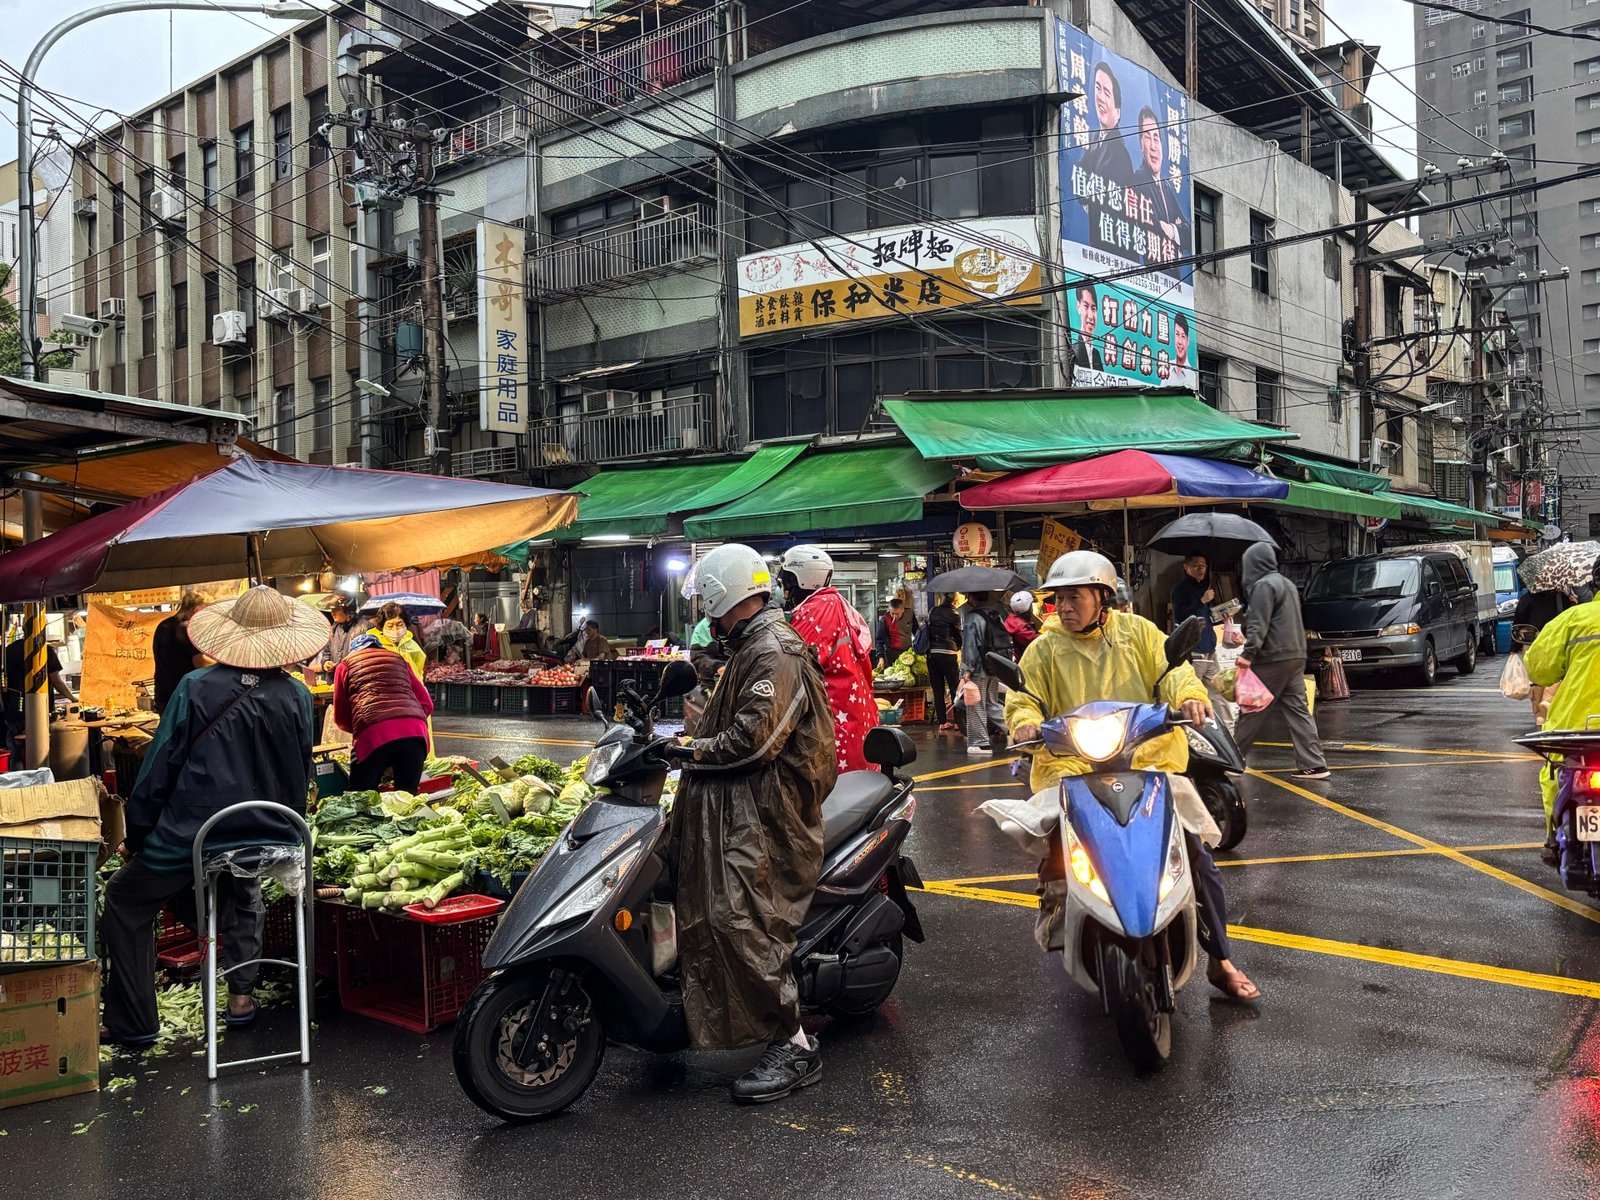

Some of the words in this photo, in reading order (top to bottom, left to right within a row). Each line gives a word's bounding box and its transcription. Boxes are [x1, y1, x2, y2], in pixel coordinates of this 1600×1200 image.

[1071, 164, 1154, 226] 值得您信任
[871, 229, 954, 268] 招牌麵
[1098, 211, 1177, 265] 值得您期待
[767, 295, 778, 326] 食品
[779, 293, 790, 324] 飲料
[810, 280, 943, 319] 保和米店
[1104, 333, 1170, 380] 共創未來
[496, 329, 519, 424] 家庭用品
[1579, 815, 1600, 833] NS
[0, 1044, 50, 1076] 菠菜
